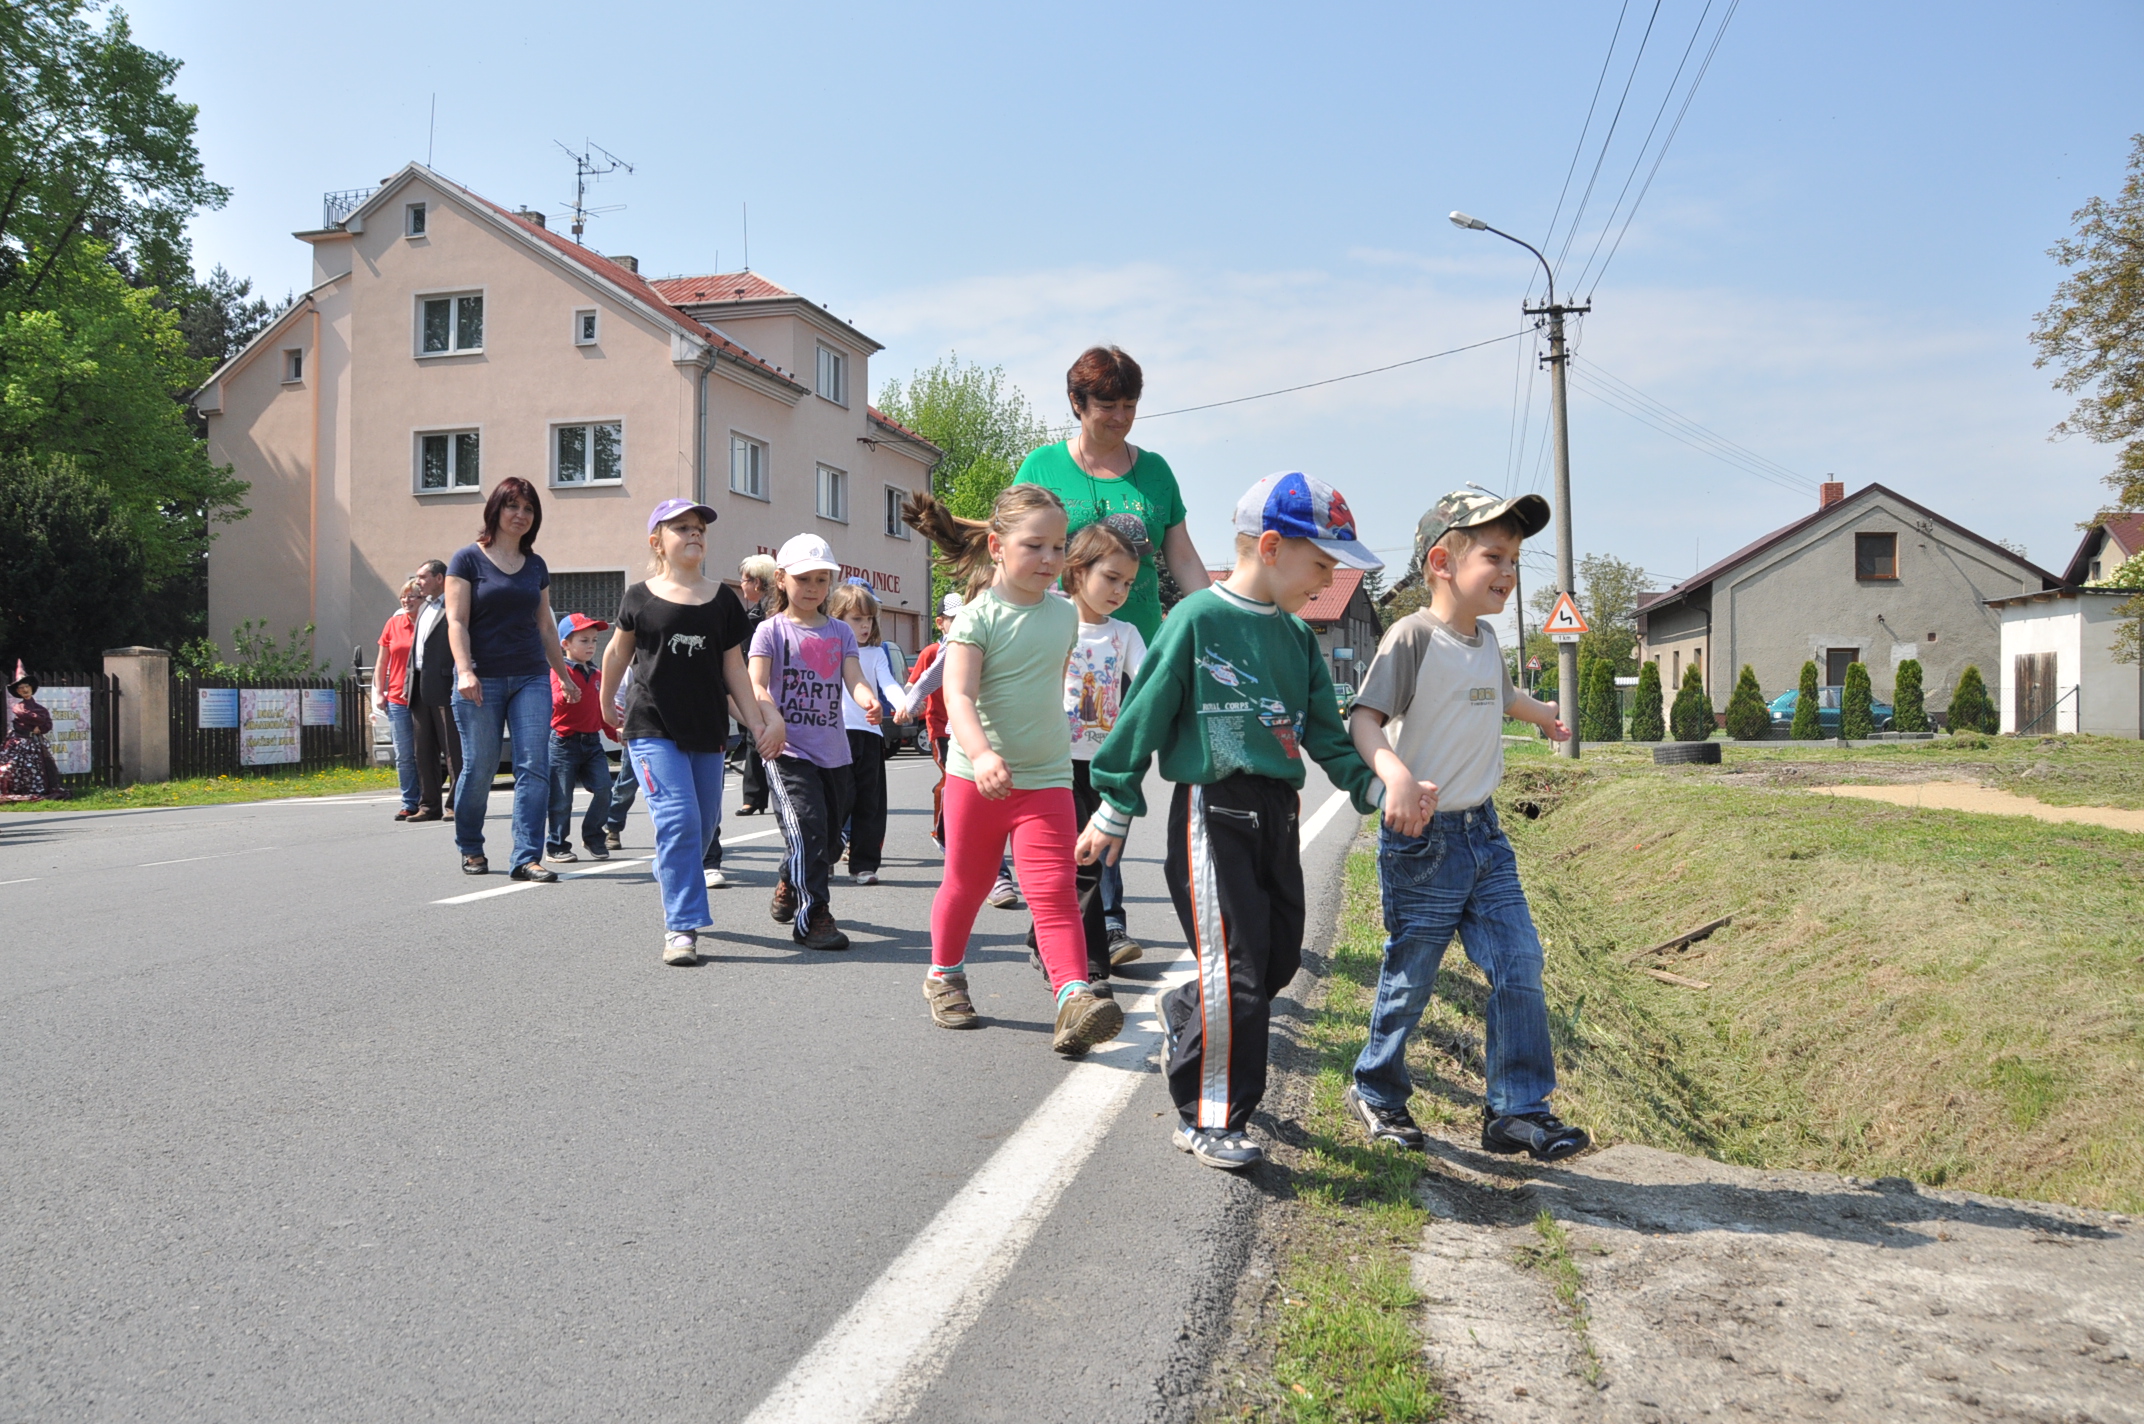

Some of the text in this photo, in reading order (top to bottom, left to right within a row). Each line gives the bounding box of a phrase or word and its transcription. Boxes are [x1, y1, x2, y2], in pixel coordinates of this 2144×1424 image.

[838, 563, 900, 594] ZBROJNICE
[784, 639, 790, 666] I
[780, 667, 841, 704] PARTY
[799, 670, 815, 681] TO
[780, 706, 827, 727] LONG
[786, 698, 820, 713] ALL
[828, 700, 839, 729] DAY
[1224, 701, 1249, 710] CORPS
